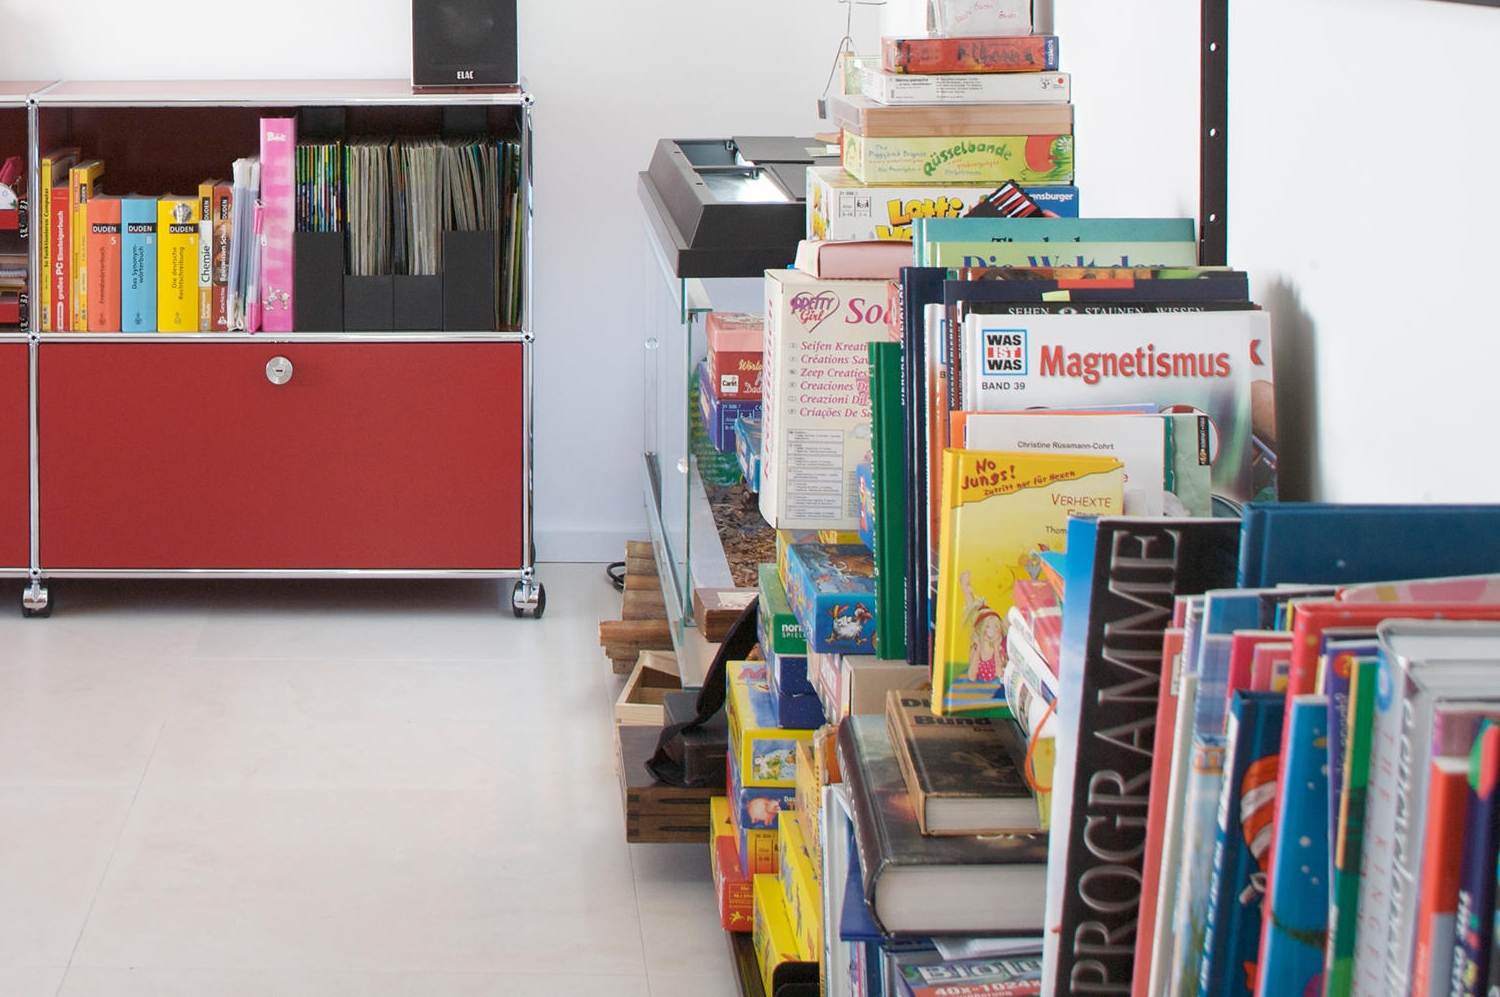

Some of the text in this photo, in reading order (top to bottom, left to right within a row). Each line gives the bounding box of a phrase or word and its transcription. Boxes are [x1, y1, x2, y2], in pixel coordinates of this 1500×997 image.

[1046, 39, 1054, 66] KOSMOS
[456, 71, 474, 80] ELAC
[924, 140, 1013, 177] Rüsselbande
[1029, 191, 1074, 201] ensburger
[886, 195, 964, 227] Lotti
[93, 225, 117, 233] DUDEN
[128, 225, 153, 233] DUDEN
[56, 261, 65, 276] PC
[201, 245, 211, 283] Chemie
[178, 246, 186, 300] Rechtschreibung
[57, 277, 65, 300] großes
[799, 310, 825, 324] Girl
[1008, 307, 1050, 315] SEHEN
[987, 334, 1022, 346] WAS
[801, 341, 832, 353] Seifen
[987, 346, 1022, 358] IST
[801, 354, 849, 364] Créations
[987, 359, 1022, 371] WAS
[1039, 344, 1231, 386] Magnetismus
[801, 367, 868, 379] Zeep Creaties
[800, 380, 854, 391] Creaciones
[981, 381, 1026, 390] BAND 39
[800, 394, 849, 404] Creazioni
[800, 407, 841, 419] Criações
[844, 407, 858, 417] De
[1017, 440, 1114, 450] Christine Rüssmann-Cohrt
[976, 458, 997, 472] No
[961, 465, 1016, 490] Jungs!
[984, 471, 1076, 496] Zutritt nur für Hexen
[1051, 493, 1112, 509] VERHEXTE
[1045, 525, 1067, 536] Thom
[1069, 528, 1184, 997] PROGRAMME
[1210, 872, 1220, 905] CAT
[1199, 955, 1210, 992] HAT
